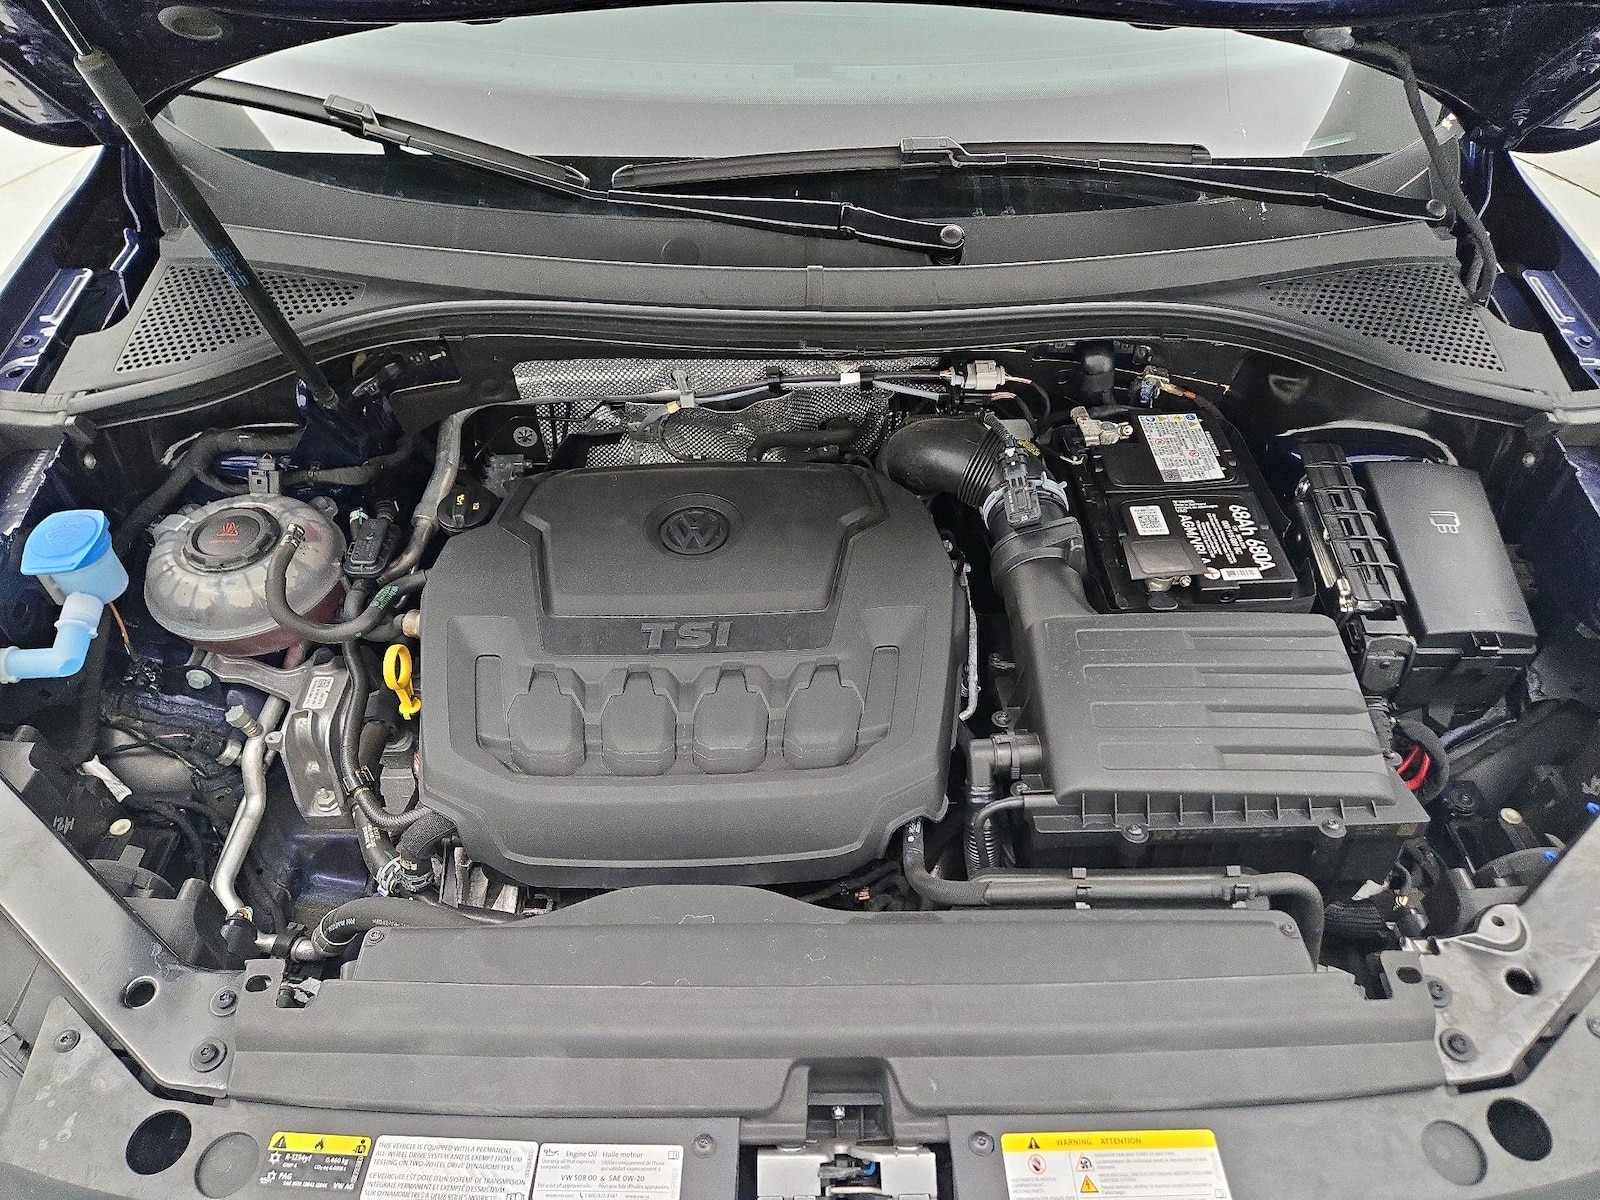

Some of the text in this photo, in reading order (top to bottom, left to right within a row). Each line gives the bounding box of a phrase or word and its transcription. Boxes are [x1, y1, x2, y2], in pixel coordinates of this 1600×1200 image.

[664, 508, 727, 553] VW
[1228, 504, 1276, 572] 68Ah 680A
[641, 622, 733, 649] TSI
[284, 1153, 312, 1163] R-1234yf
